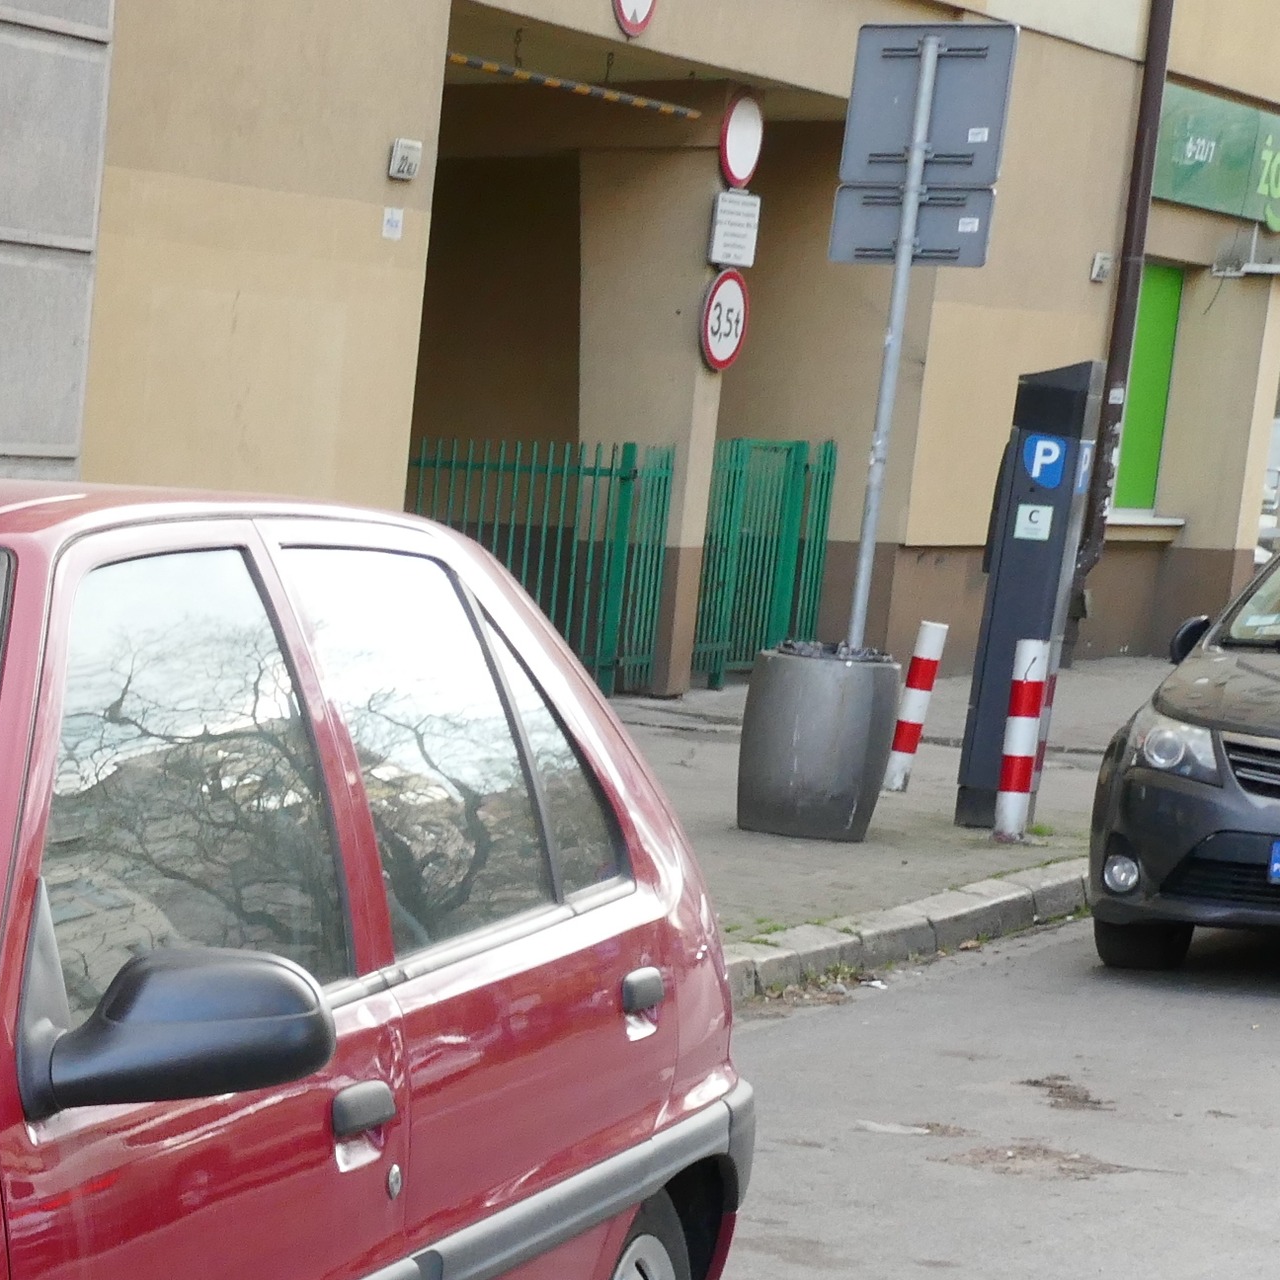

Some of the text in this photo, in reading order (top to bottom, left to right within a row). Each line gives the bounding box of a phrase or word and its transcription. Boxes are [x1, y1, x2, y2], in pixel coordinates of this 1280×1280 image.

[711, 302, 741, 343] 3,5t
[1031, 440, 1060, 478] P
[1028, 509, 1040, 524] C
